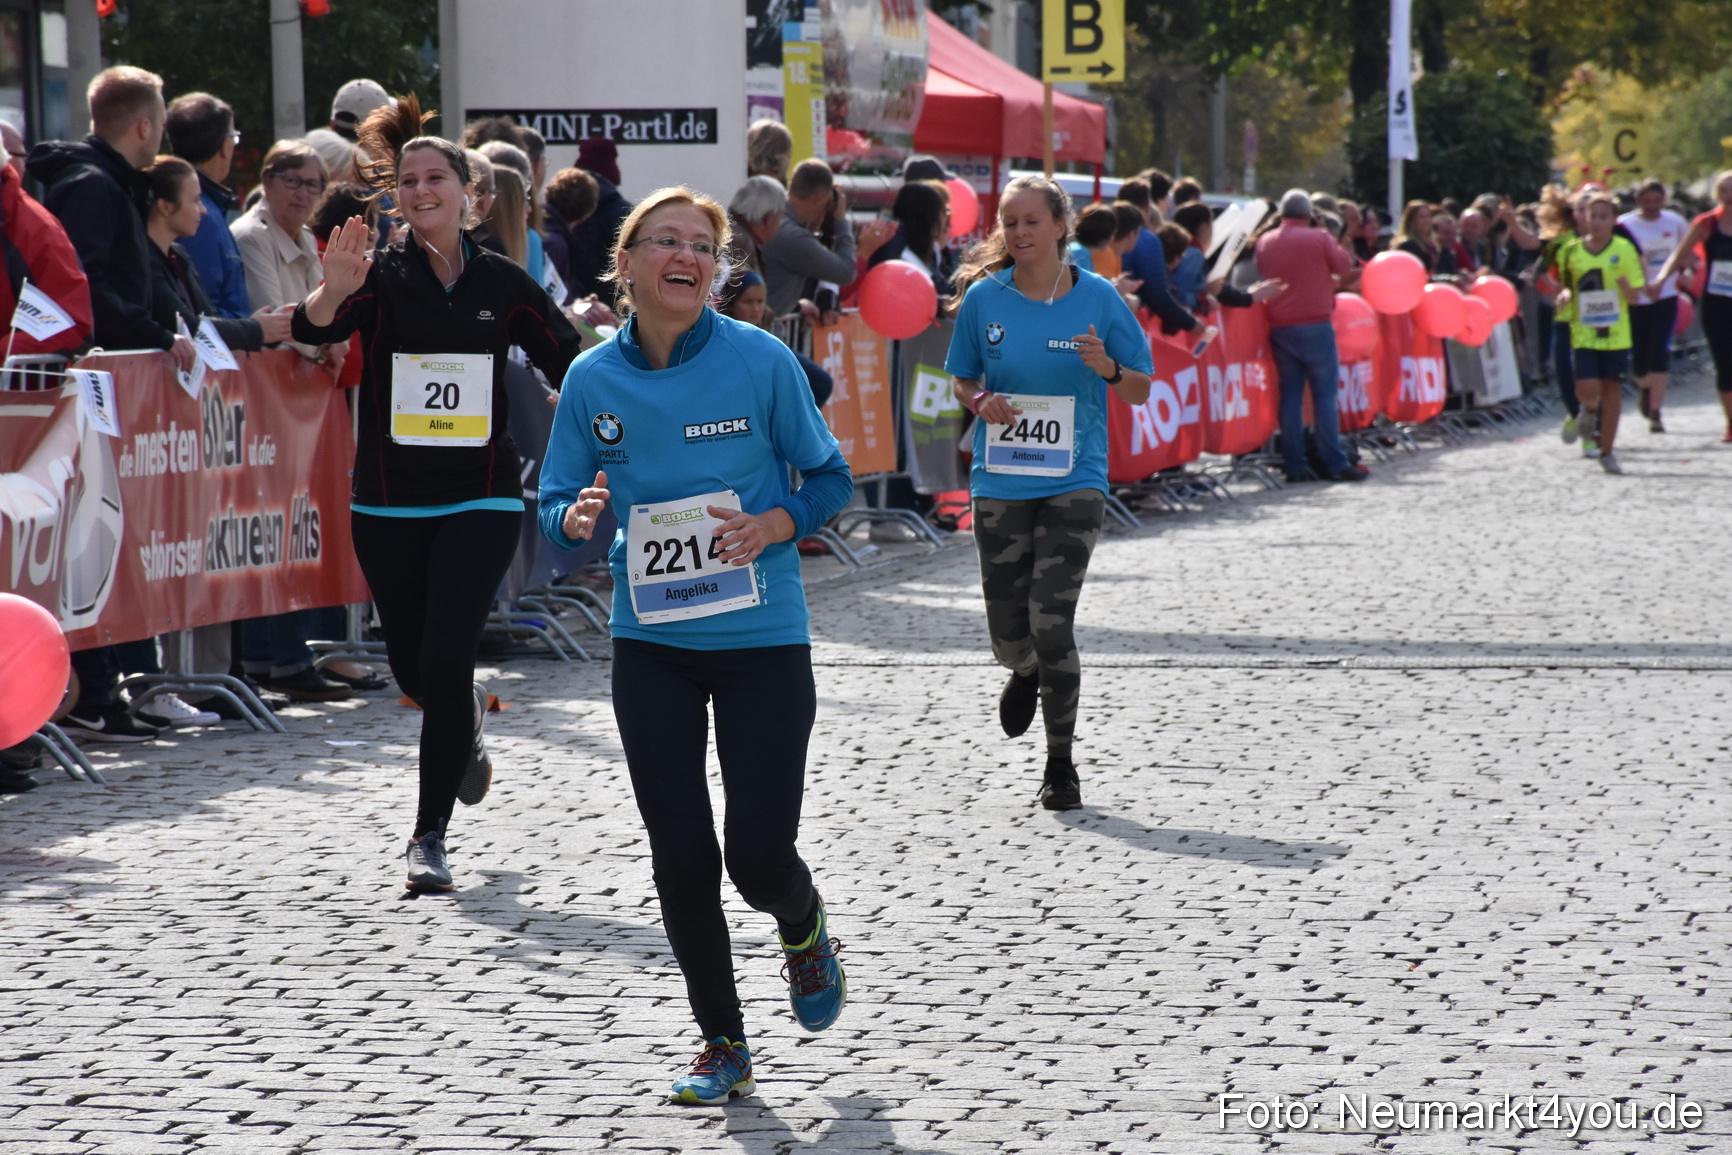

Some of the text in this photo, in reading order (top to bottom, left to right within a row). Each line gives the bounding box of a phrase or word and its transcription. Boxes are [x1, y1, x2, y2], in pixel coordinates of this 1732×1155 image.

[1064, 0, 1104, 55] B
[1613, 129, 1637, 162] C
[430, 361, 465, 371] BOCK
[424, 381, 460, 411] 20
[1019, 401, 1050, 410] BOCK
[201, 384, 245, 471] 80er
[429, 419, 454, 430] Aline
[684, 417, 751, 439] BOCK
[999, 418, 1061, 444] 2440
[598, 450, 629, 459] PARTL
[1011, 451, 1045, 462] Antonia
[661, 507, 704, 524] BOCK
[643, 535, 730, 577] 2214
[665, 582, 719, 601] Angelika
